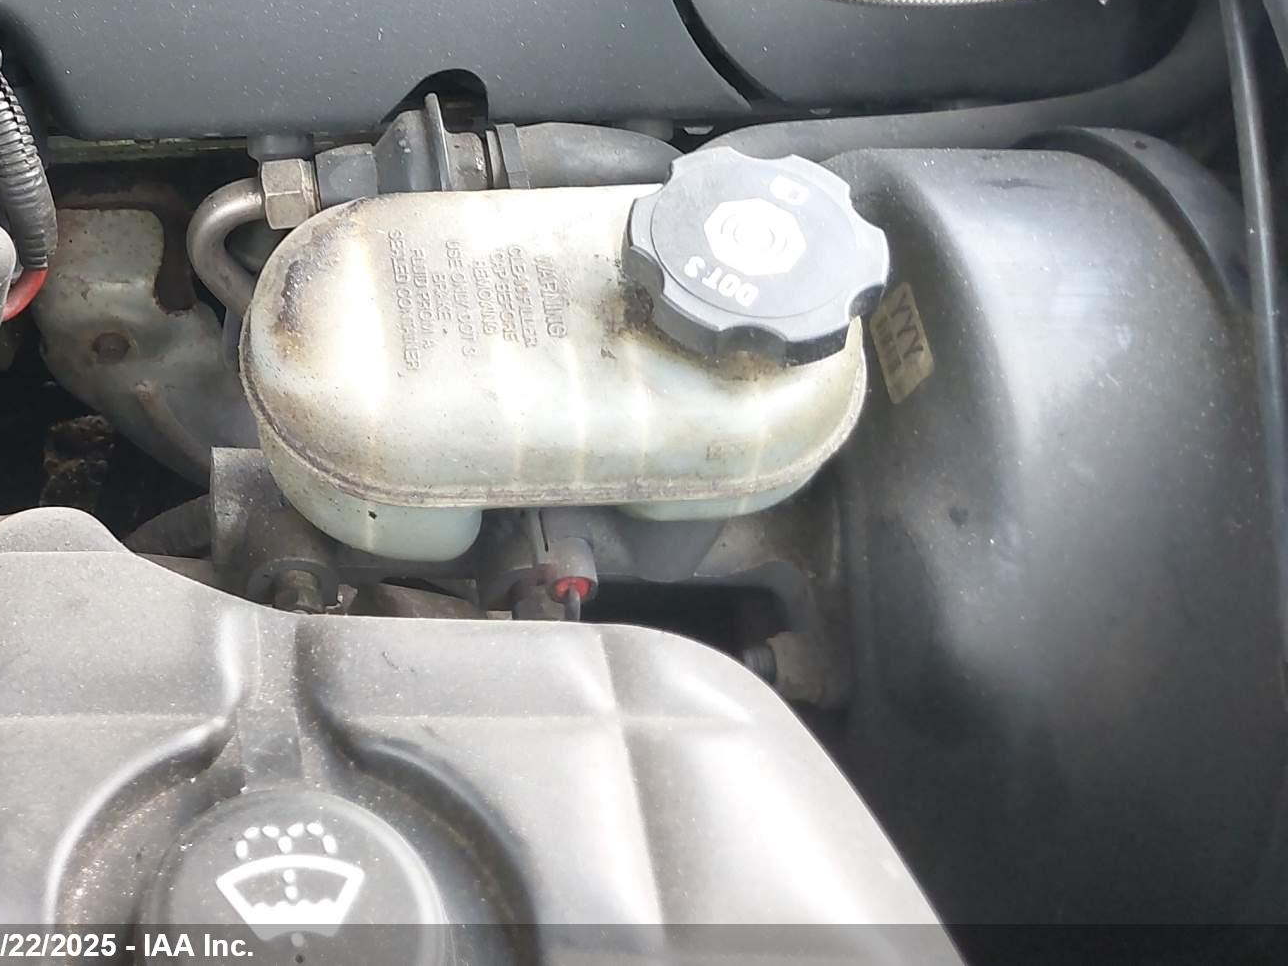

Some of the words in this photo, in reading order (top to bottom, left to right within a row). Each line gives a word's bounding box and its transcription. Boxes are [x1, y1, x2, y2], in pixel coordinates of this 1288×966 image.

[684, 256, 706, 278] 3
[702, 266, 759, 306] DOT
[533, 255, 568, 338] WARNING
